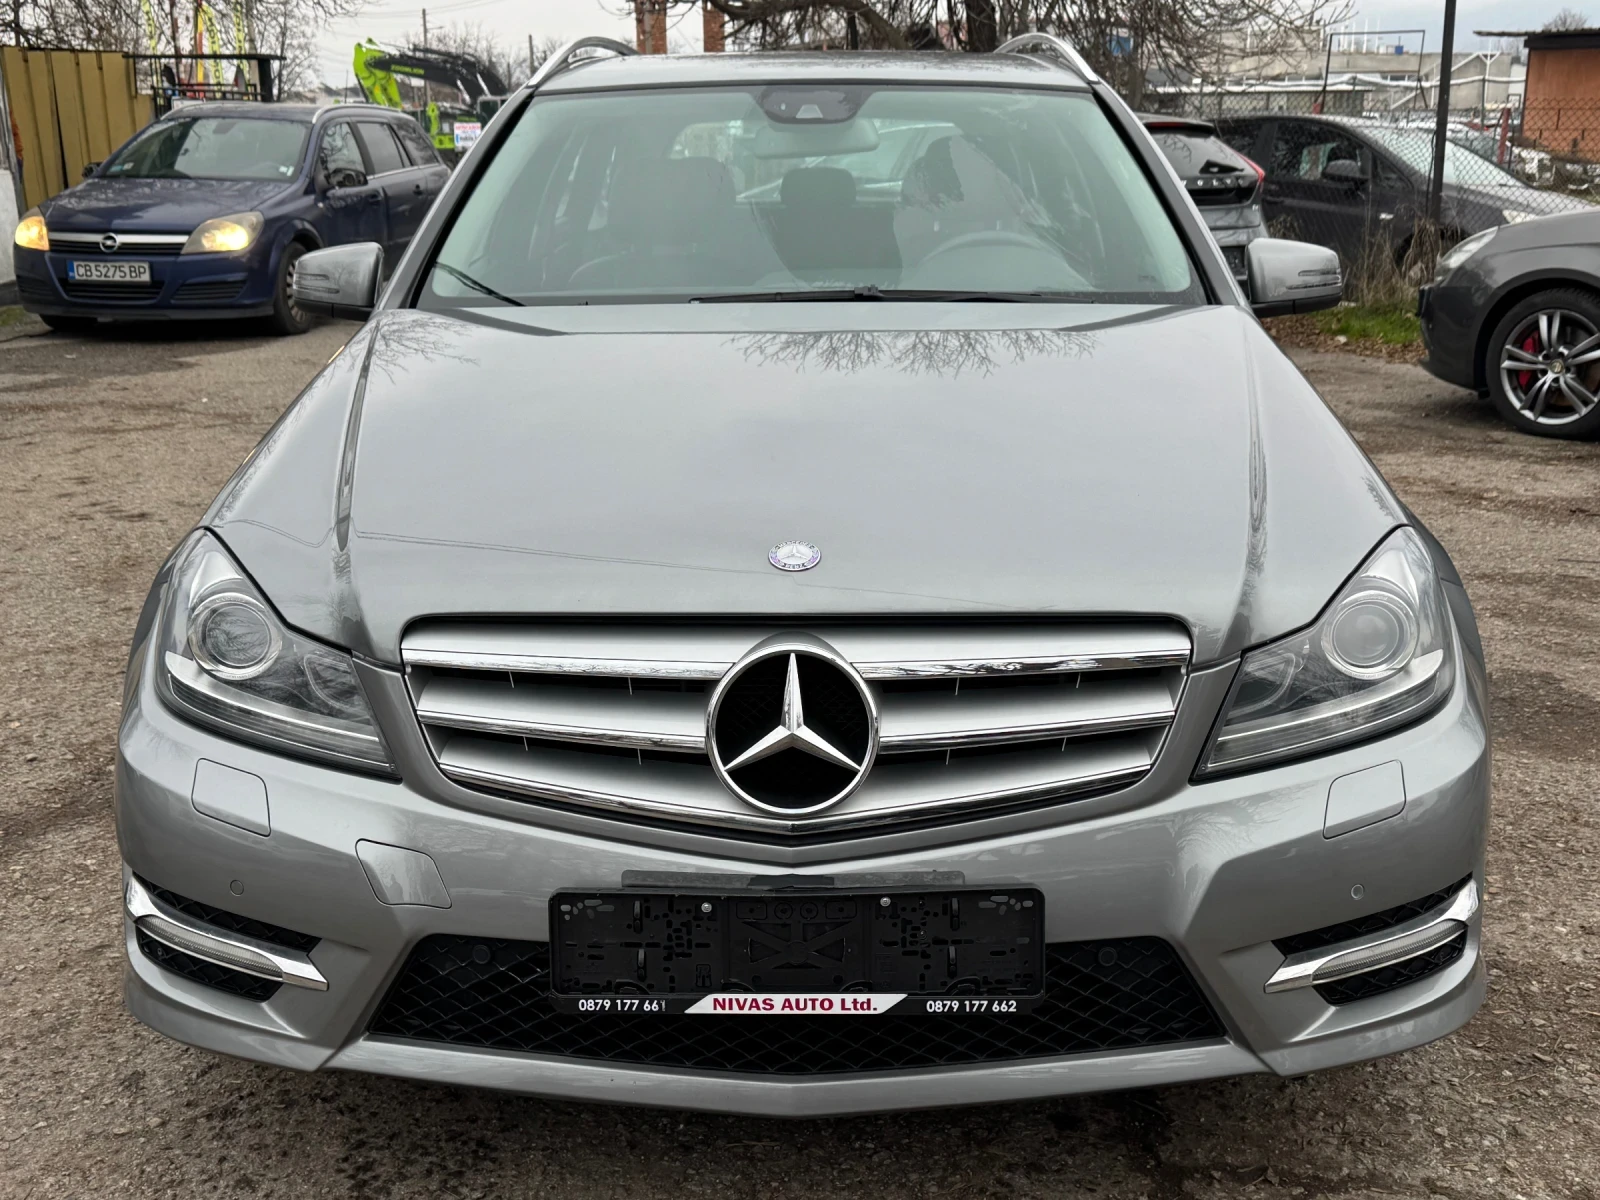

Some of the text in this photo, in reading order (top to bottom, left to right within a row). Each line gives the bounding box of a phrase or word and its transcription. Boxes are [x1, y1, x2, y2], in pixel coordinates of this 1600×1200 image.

[75, 263, 147, 279] CB 5275 BP
[578, 998, 668, 1012] 0879 177 661
[713, 998, 878, 1012] NIVAS AUTO Ltd.
[926, 999, 1017, 1013] 0879 177 662
